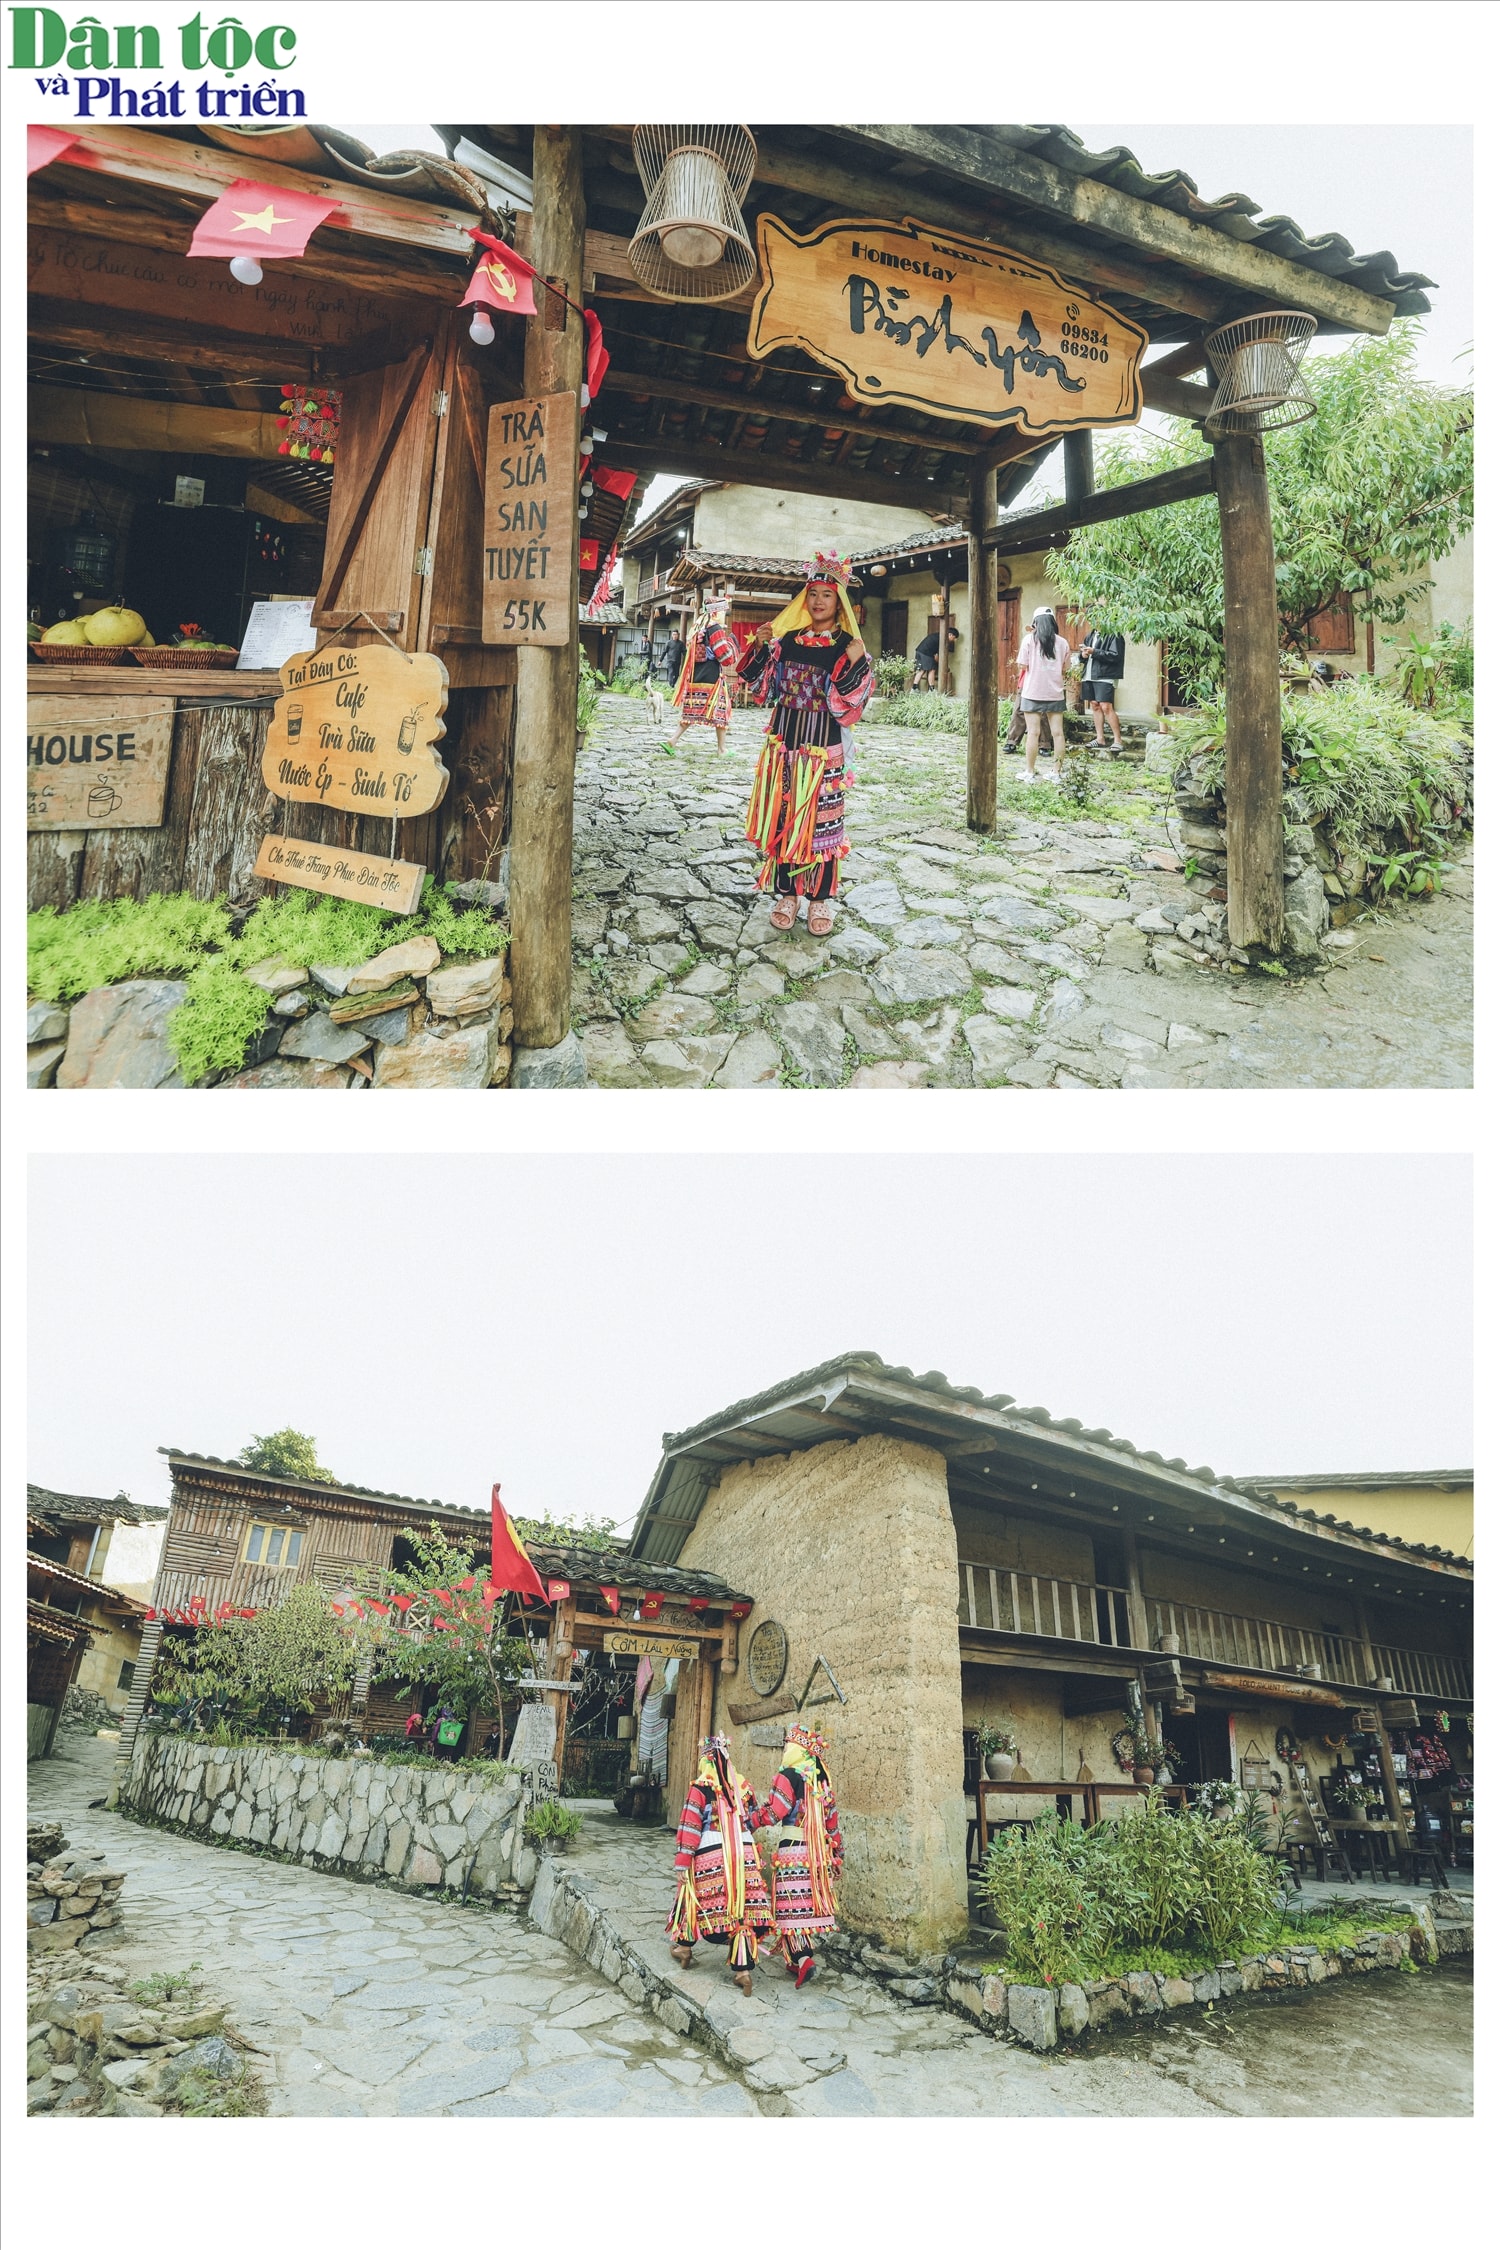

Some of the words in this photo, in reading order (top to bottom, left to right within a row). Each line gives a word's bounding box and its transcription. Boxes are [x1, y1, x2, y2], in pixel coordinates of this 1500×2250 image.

[851, 241, 958, 282] Homestay
[1061, 321, 1109, 348] 09834
[1060, 340, 1109, 365] 66200
[501, 402, 545, 444] TRÀ
[500, 443, 548, 490] SỮA
[498, 501, 547, 532] SAN
[485, 531, 551, 581] TUYẾT
[503, 600, 547, 631] 55K
[288, 665, 307, 686] Tại
[310, 661, 334, 682] Đây
[338, 653, 358, 671] Có:
[335, 681, 369, 719] Café
[27, 733, 136, 766] HOUSE
[318, 723, 343, 750] Trà
[347, 725, 376, 753] Sữa
[278, 758, 312, 787] Nước
[315, 756, 333, 799] Ép
[351, 767, 387, 798] Sinh
[393, 773, 418, 802] Tố
[268, 846, 284, 864] Cho
[284, 850, 305, 870] Thuê
[305, 855, 332, 881] Trang
[333, 860, 356, 883] Phục
